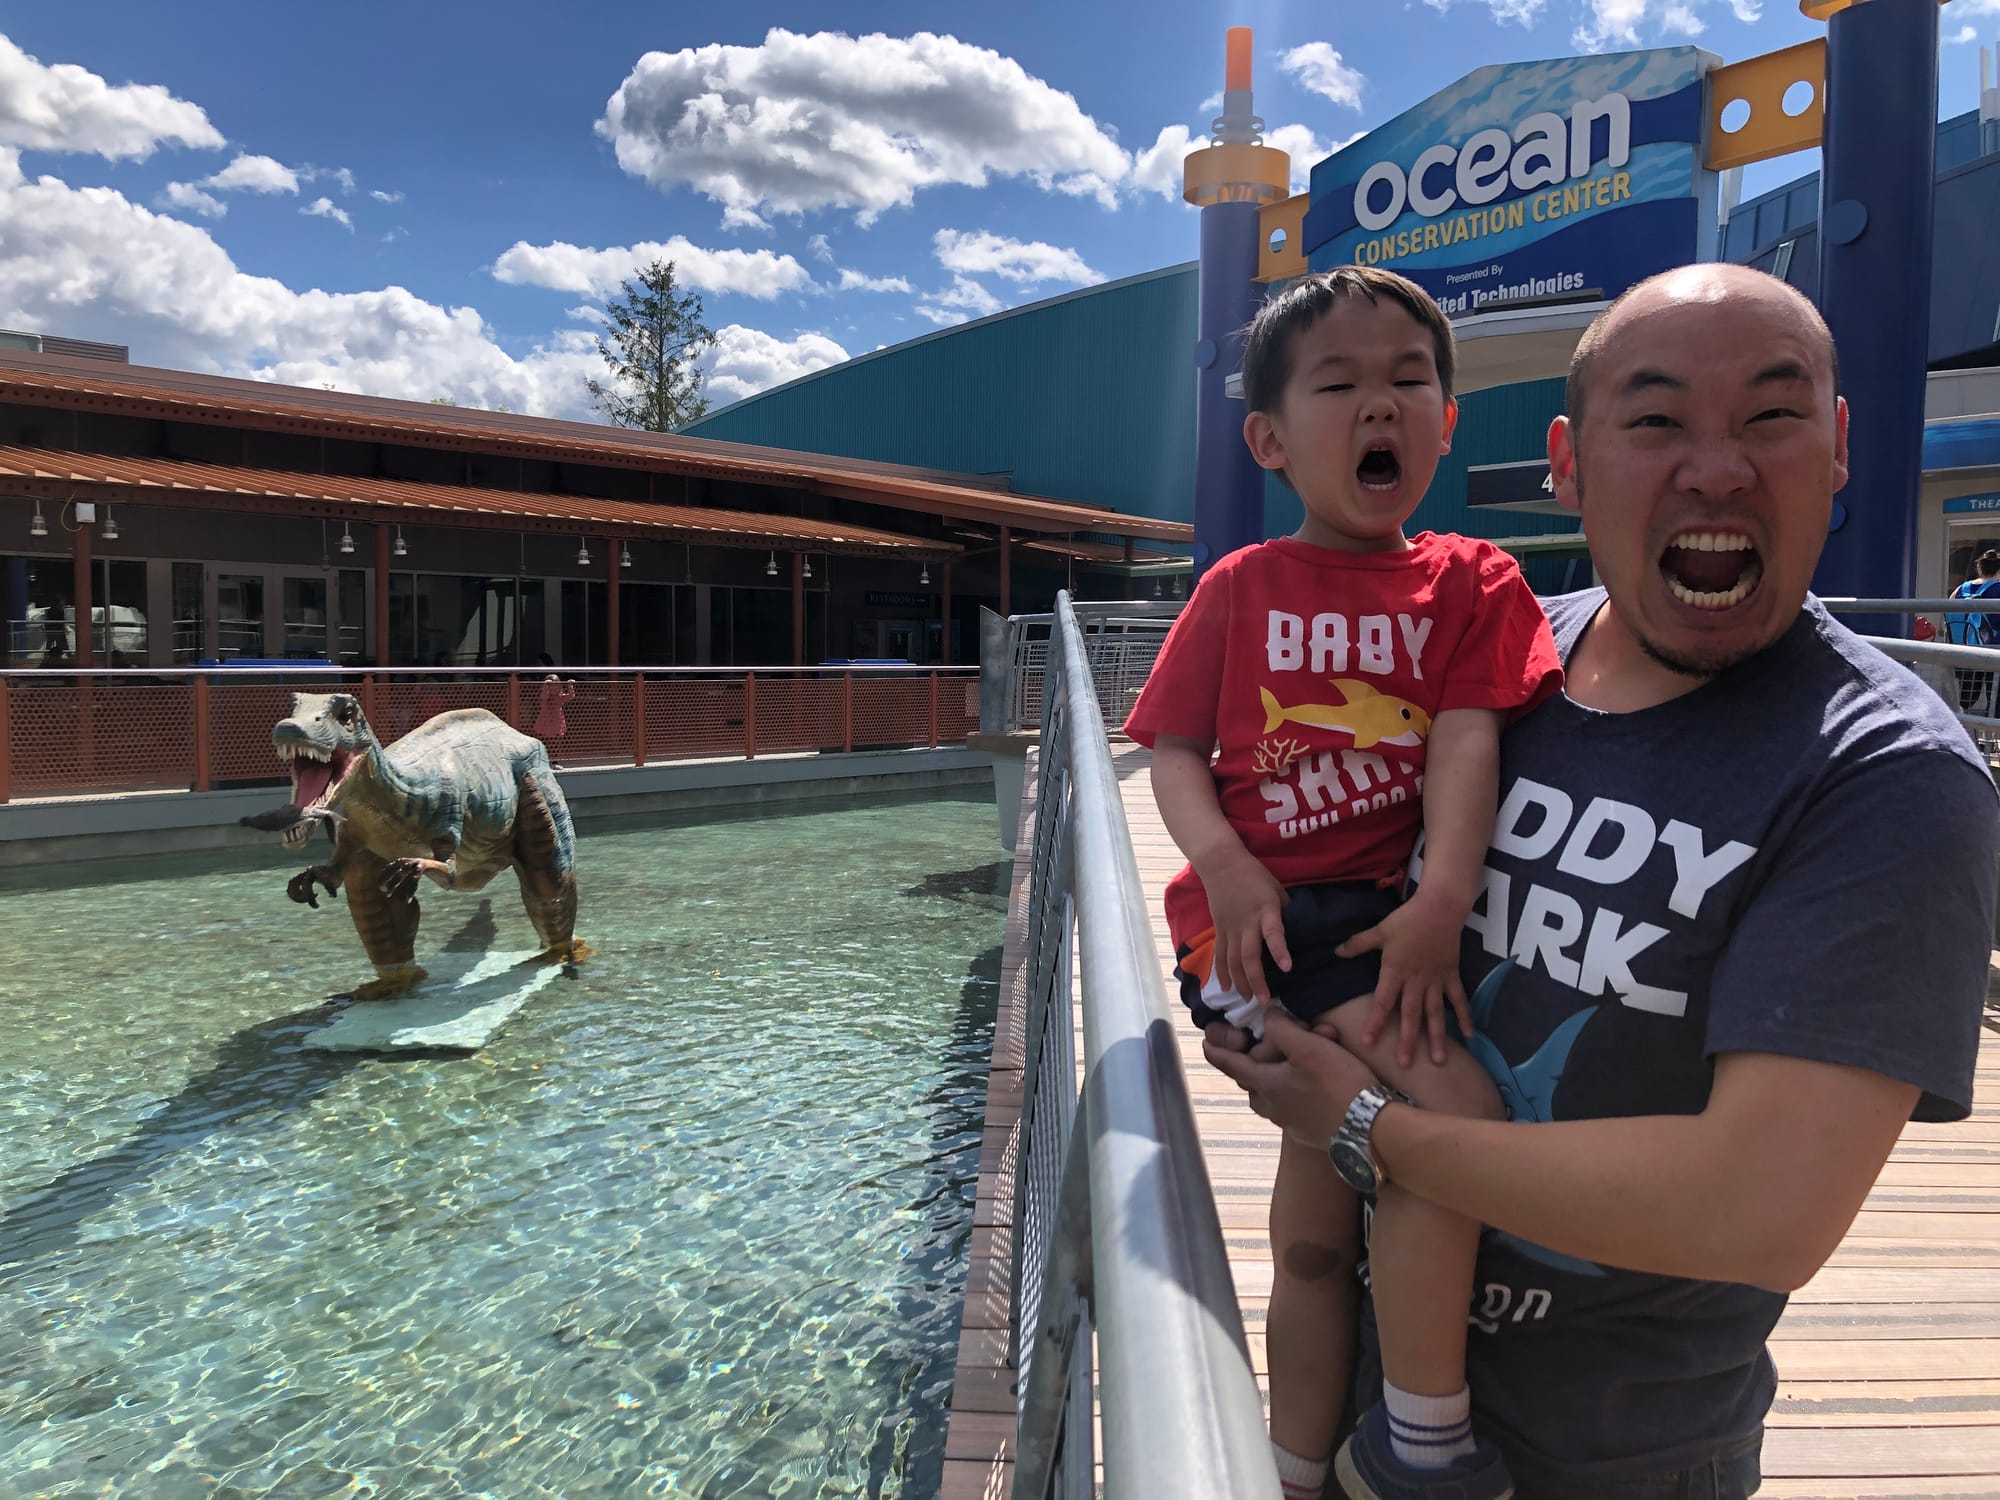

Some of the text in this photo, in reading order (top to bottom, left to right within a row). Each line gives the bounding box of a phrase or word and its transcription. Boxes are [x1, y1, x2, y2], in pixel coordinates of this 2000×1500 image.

[1354, 93, 1630, 231] ocean
[1354, 172, 1632, 267] CONSERVATION CENTER
[1437, 272, 1584, 314] ited Technologies
[1446, 264, 1504, 285] Presented By
[1265, 610, 1434, 680] BABY
[1259, 750, 1414, 824] SHA
[1490, 776, 1758, 920] DDY
[1463, 865, 1688, 1017] ARK
